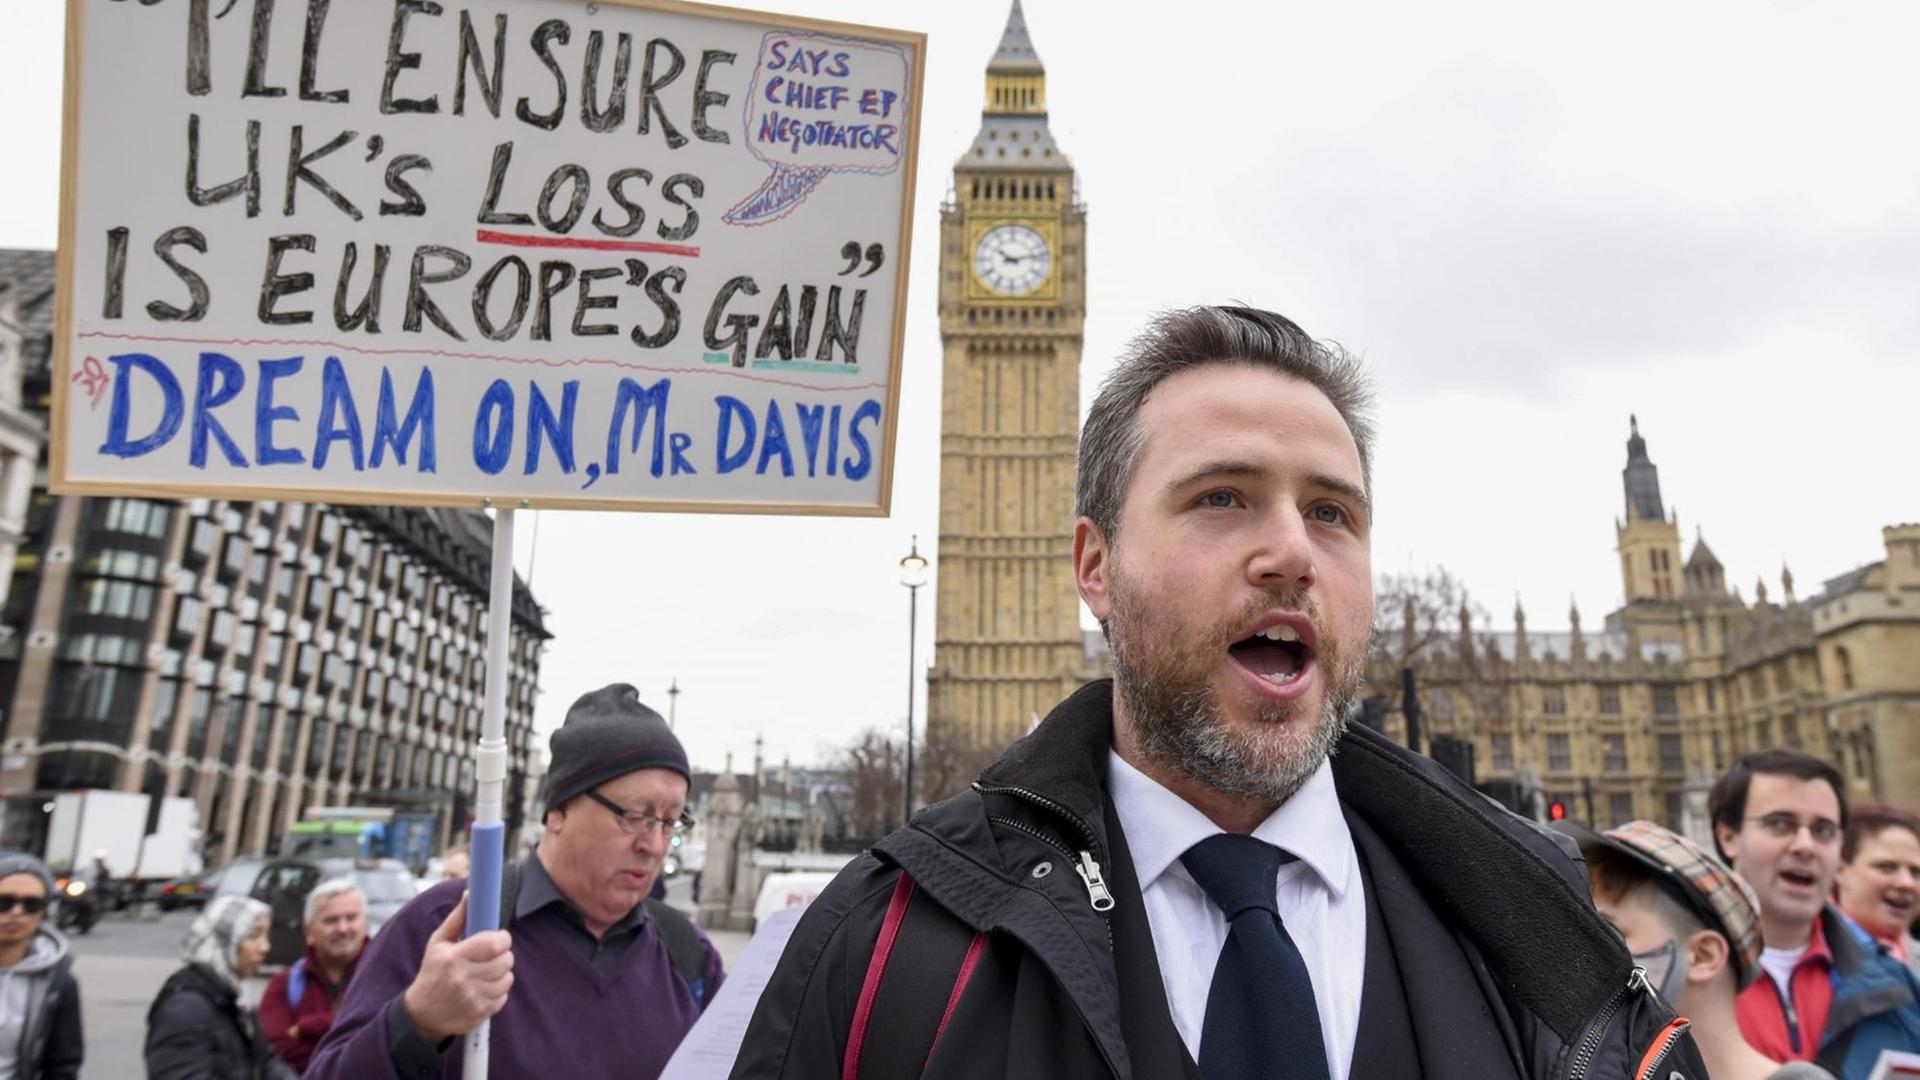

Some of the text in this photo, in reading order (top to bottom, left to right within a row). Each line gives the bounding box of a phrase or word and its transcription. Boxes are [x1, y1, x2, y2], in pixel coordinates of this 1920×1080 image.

[109, 0, 737, 149] I'LL ENSURE
[765, 76, 898, 119] CHIEF EP
[767, 40, 851, 78] SAYS
[477, 141, 705, 241] LOSS
[103, 225, 211, 322] IS
[258, 234, 687, 350] EUROPE'S
[98, 352, 437, 475] DREAM
[472, 378, 600, 489] ON,
[714, 395, 882, 481] DAVIS
